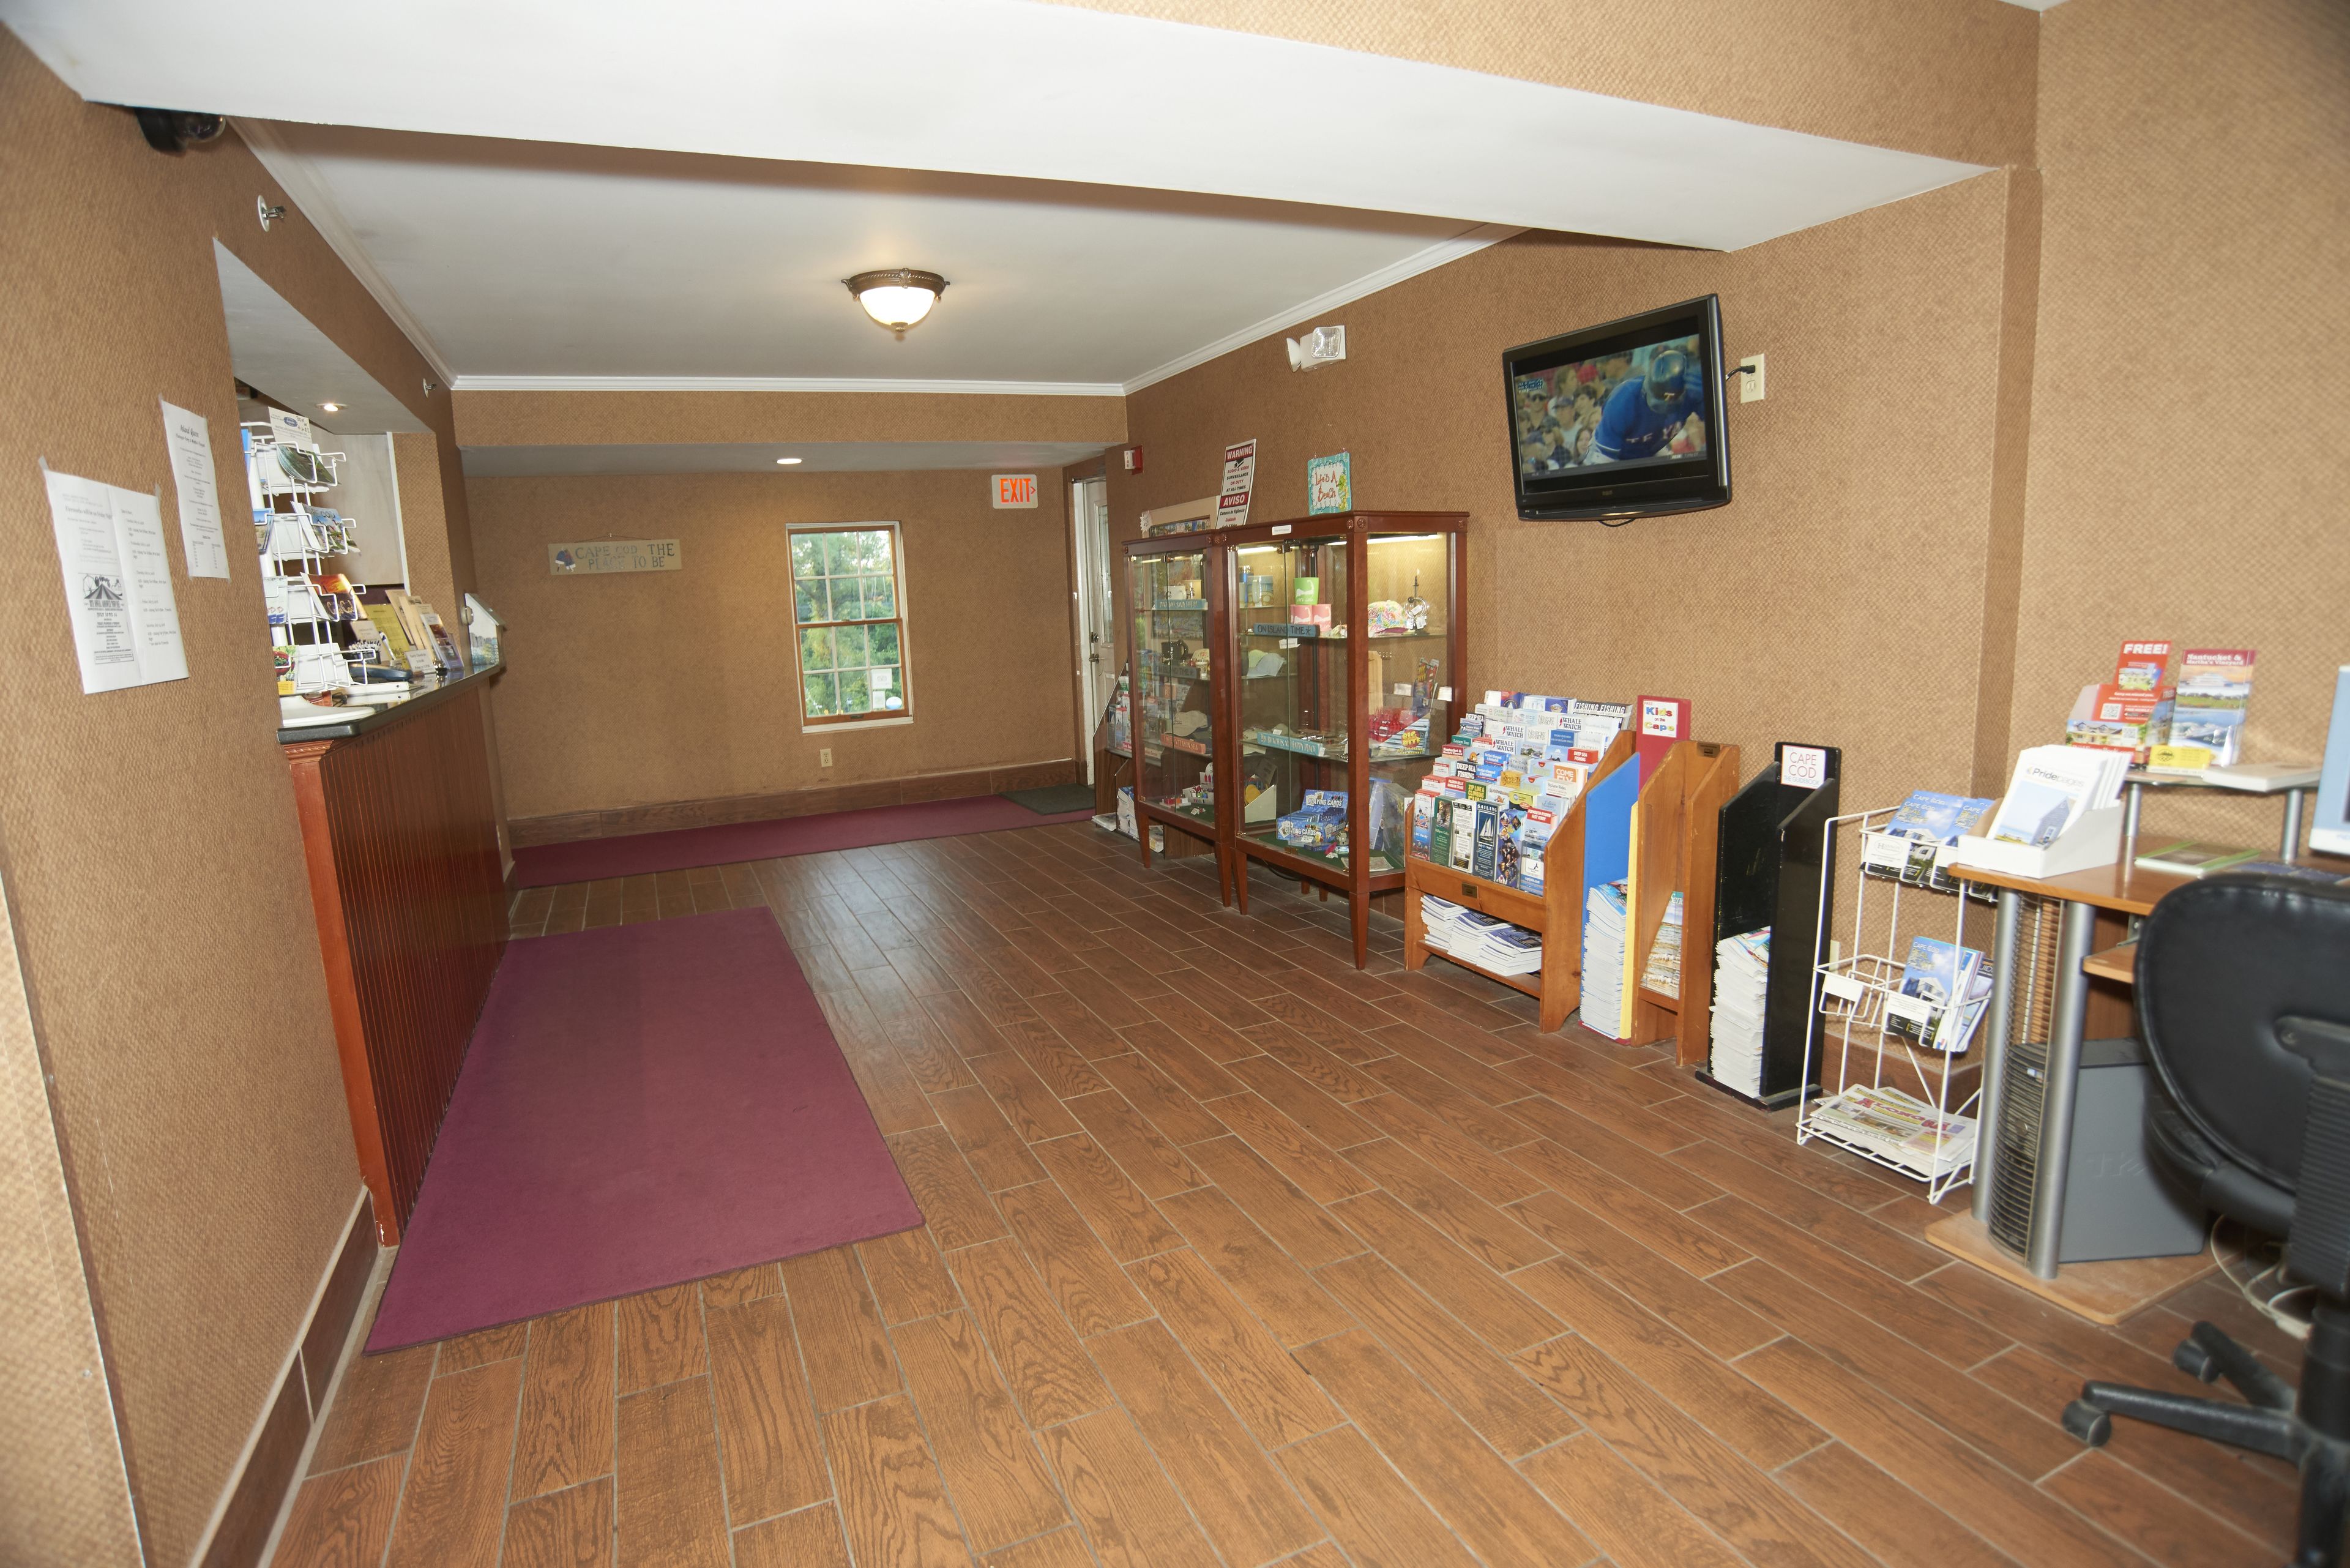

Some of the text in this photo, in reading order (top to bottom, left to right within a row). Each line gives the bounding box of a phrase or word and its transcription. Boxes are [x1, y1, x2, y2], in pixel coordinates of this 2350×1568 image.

[1227, 446, 1253, 460] WARNING
[1315, 470, 1337, 489] Life's A
[999, 478, 1031, 502] EXIT
[1223, 494, 1245, 506] AVISO
[575, 543, 675, 559] CAPE COD THE
[588, 556, 665, 570] PLACE TO BE
[1267, 625, 1288, 634] ISLAND
[1291, 625, 1305, 634] TIME
[2124, 644, 2168, 654] FREE!
[1600, 704, 1625, 714] FISHING
[1646, 707, 1673, 717] Kids
[1644, 722, 1675, 731] Cape
[1403, 737, 1421, 745] BITE
[1789, 752, 1817, 766] CAPE
[1457, 771, 1474, 779] FISHING
[1556, 769, 1574, 777] COME
[1789, 765, 1816, 778] COD
[1477, 804, 1497, 812] SAILING
[1856, 1097, 1926, 1121] ALONG
